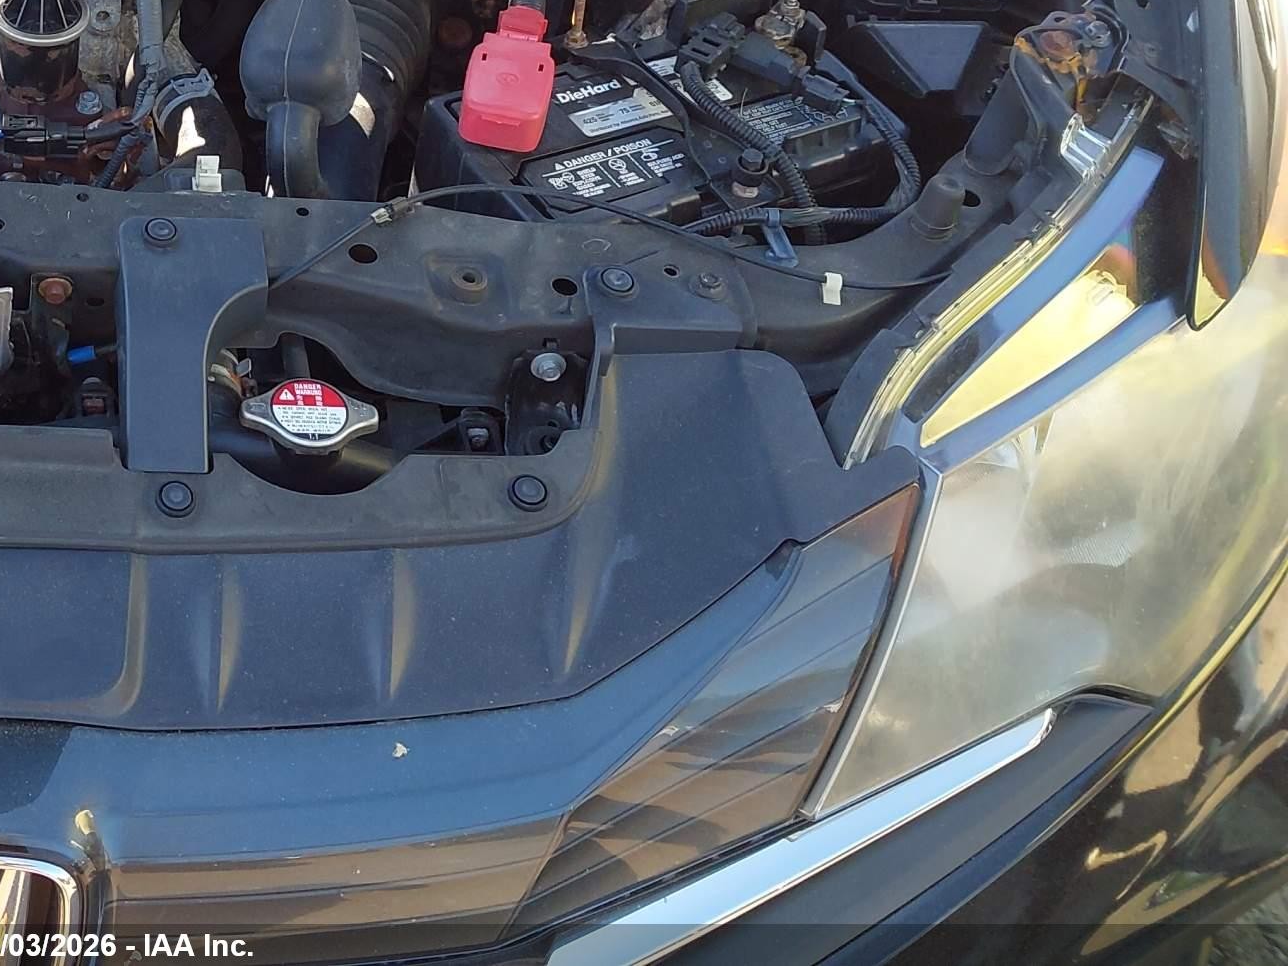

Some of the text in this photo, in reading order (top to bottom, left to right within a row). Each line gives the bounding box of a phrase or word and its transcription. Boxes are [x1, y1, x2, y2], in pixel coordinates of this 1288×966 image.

[555, 78, 622, 104] DieHard
[563, 151, 607, 168] DANGER
[613, 138, 652, 154] POISON
